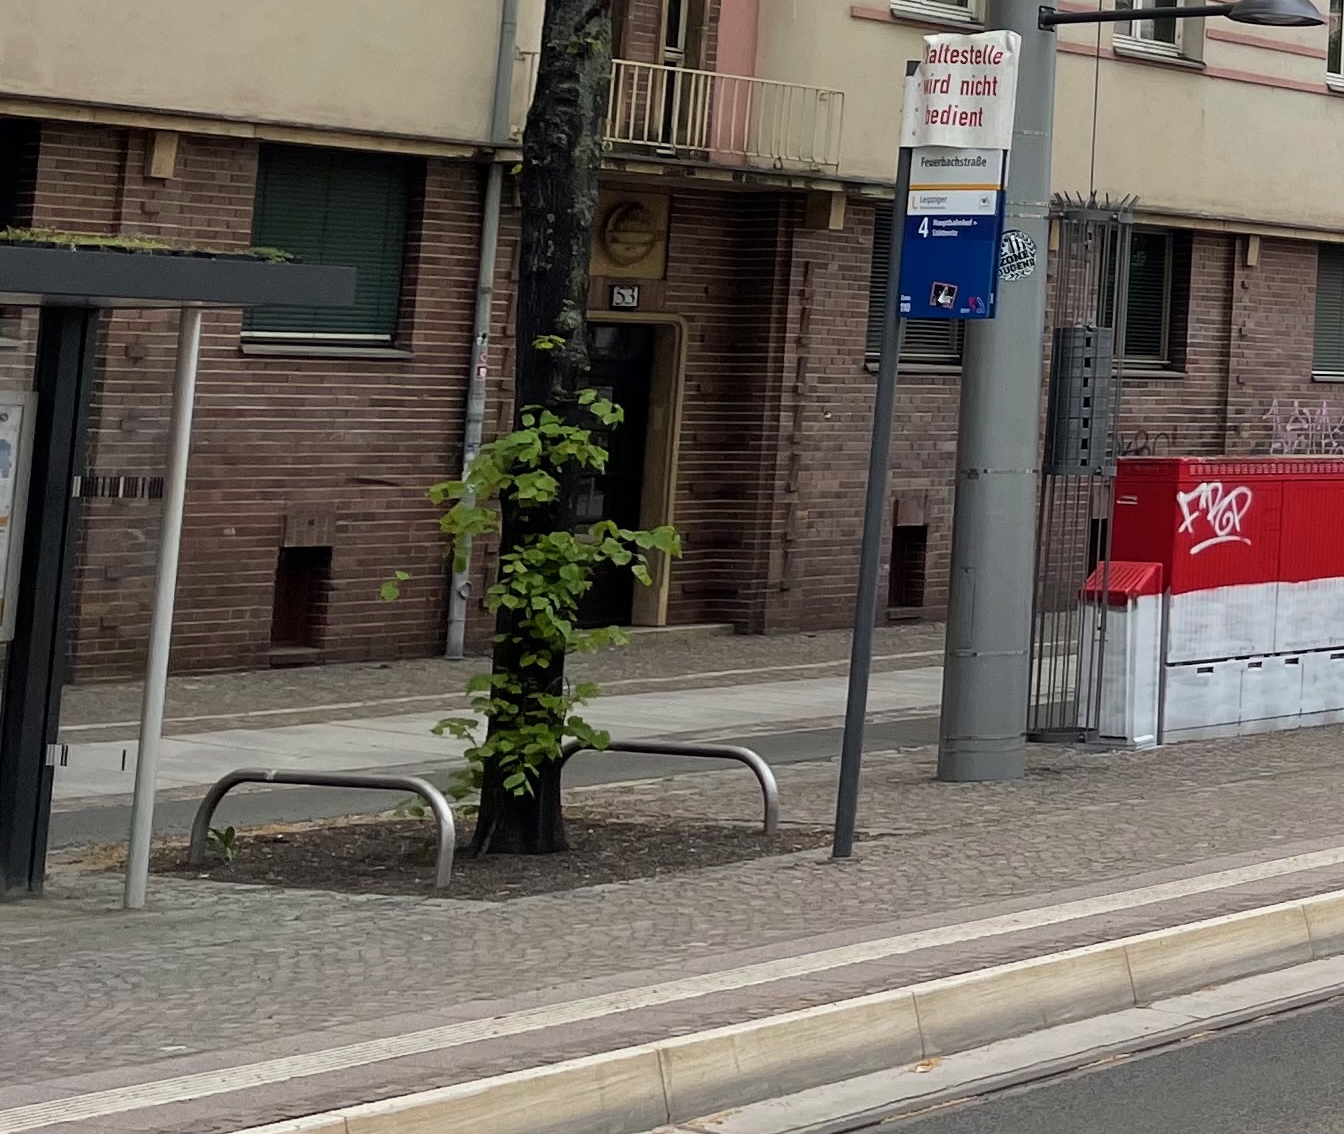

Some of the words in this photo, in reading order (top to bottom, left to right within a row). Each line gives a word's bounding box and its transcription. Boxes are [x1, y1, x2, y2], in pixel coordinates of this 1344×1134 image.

[960, 74, 998, 96] nicht
[920, 155, 987, 167] Feuerbachstraße
[918, 216, 929, 238] 4
[615, 286, 635, 305] 53
